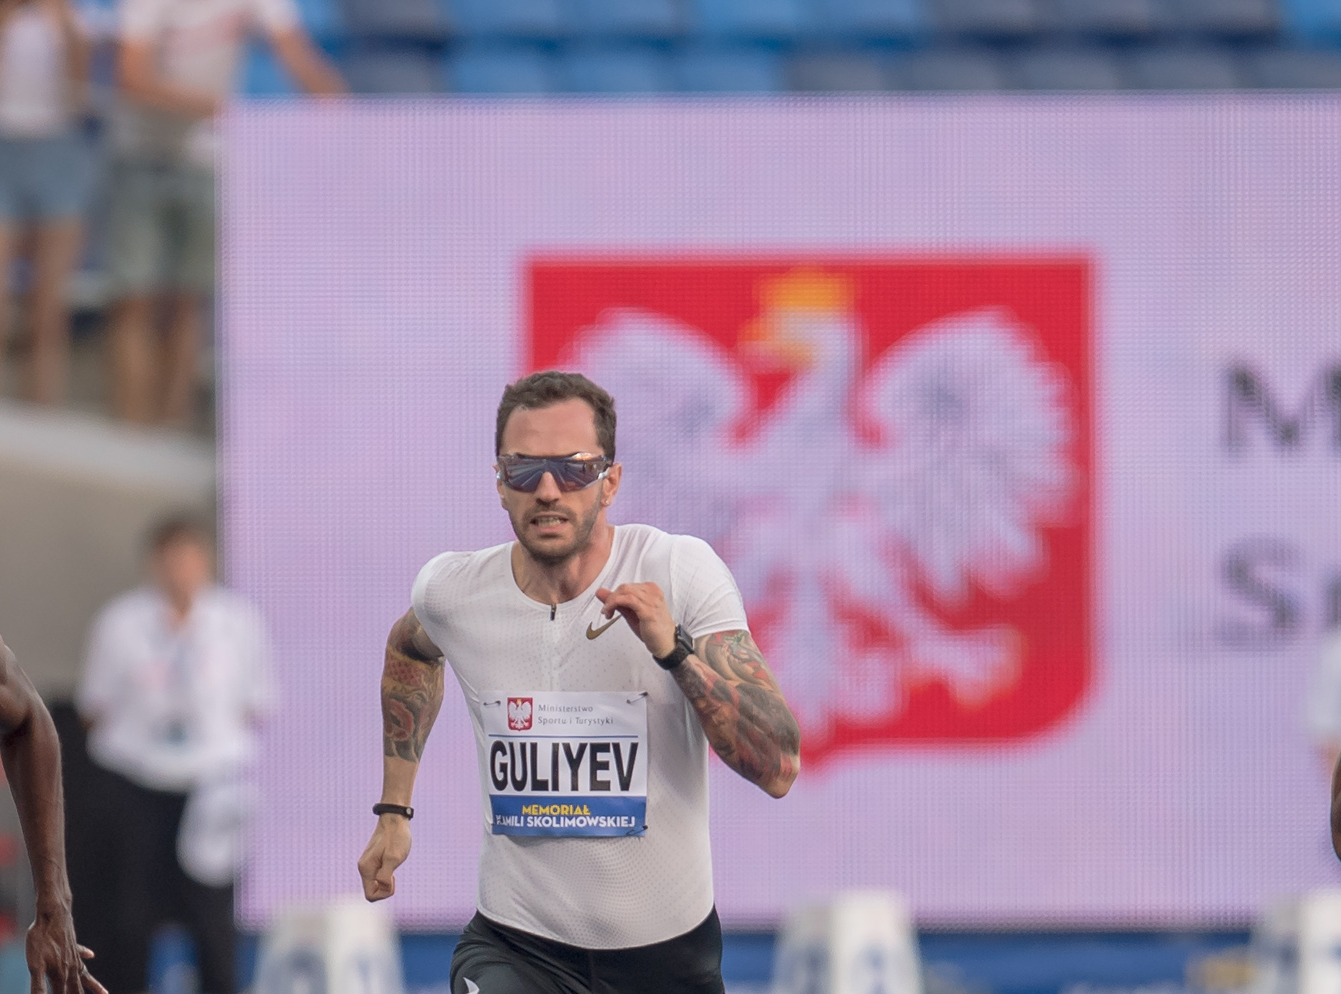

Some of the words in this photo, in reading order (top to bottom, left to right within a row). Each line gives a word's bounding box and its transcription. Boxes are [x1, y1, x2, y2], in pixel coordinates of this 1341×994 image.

[490, 740, 639, 792] GULIYEV
[522, 804, 591, 816] MEMORIAŁ
[526, 815, 636, 828] SKOLIMOWSKIEJ
